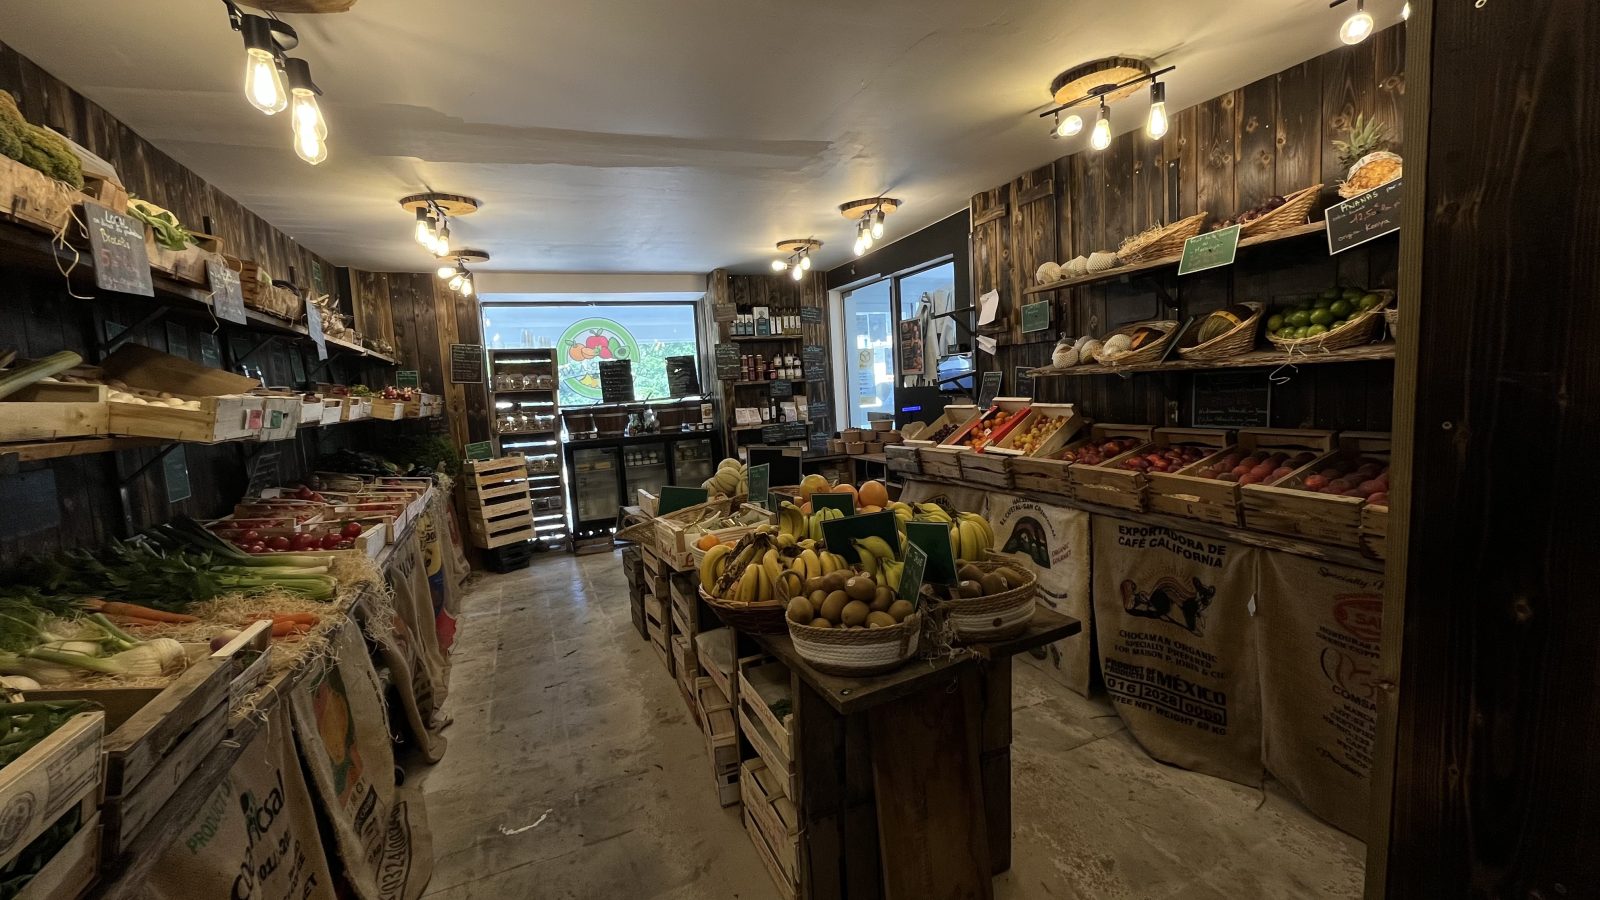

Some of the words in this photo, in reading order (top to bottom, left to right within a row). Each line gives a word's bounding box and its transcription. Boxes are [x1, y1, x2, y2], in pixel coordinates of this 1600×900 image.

[1340, 192, 1379, 213] ANANAS
[1118, 525, 1204, 551] EXPORTADORA
[1208, 544, 1226, 556] DE
[1149, 538, 1223, 568] CALIFORNIA
[1115, 645, 1130, 654] FOR
[1132, 647, 1163, 660] MAISON
[1119, 629, 1171, 645] CHOCAMAN
[1173, 641, 1218, 664] ORGANIC
[1125, 640, 1165, 652] SPECIALLY
[1167, 647, 1212, 669] PREPARED
[1105, 657, 1144, 672] PRODUCT
[1107, 679, 1137, 693] 016
[1144, 687, 1178, 706] 2028
[1157, 671, 1226, 706] MÉXICO
[1135, 697, 1153, 711] NET
[1156, 705, 1195, 726] WEIGHT
[1212, 726, 1226, 736] KG
